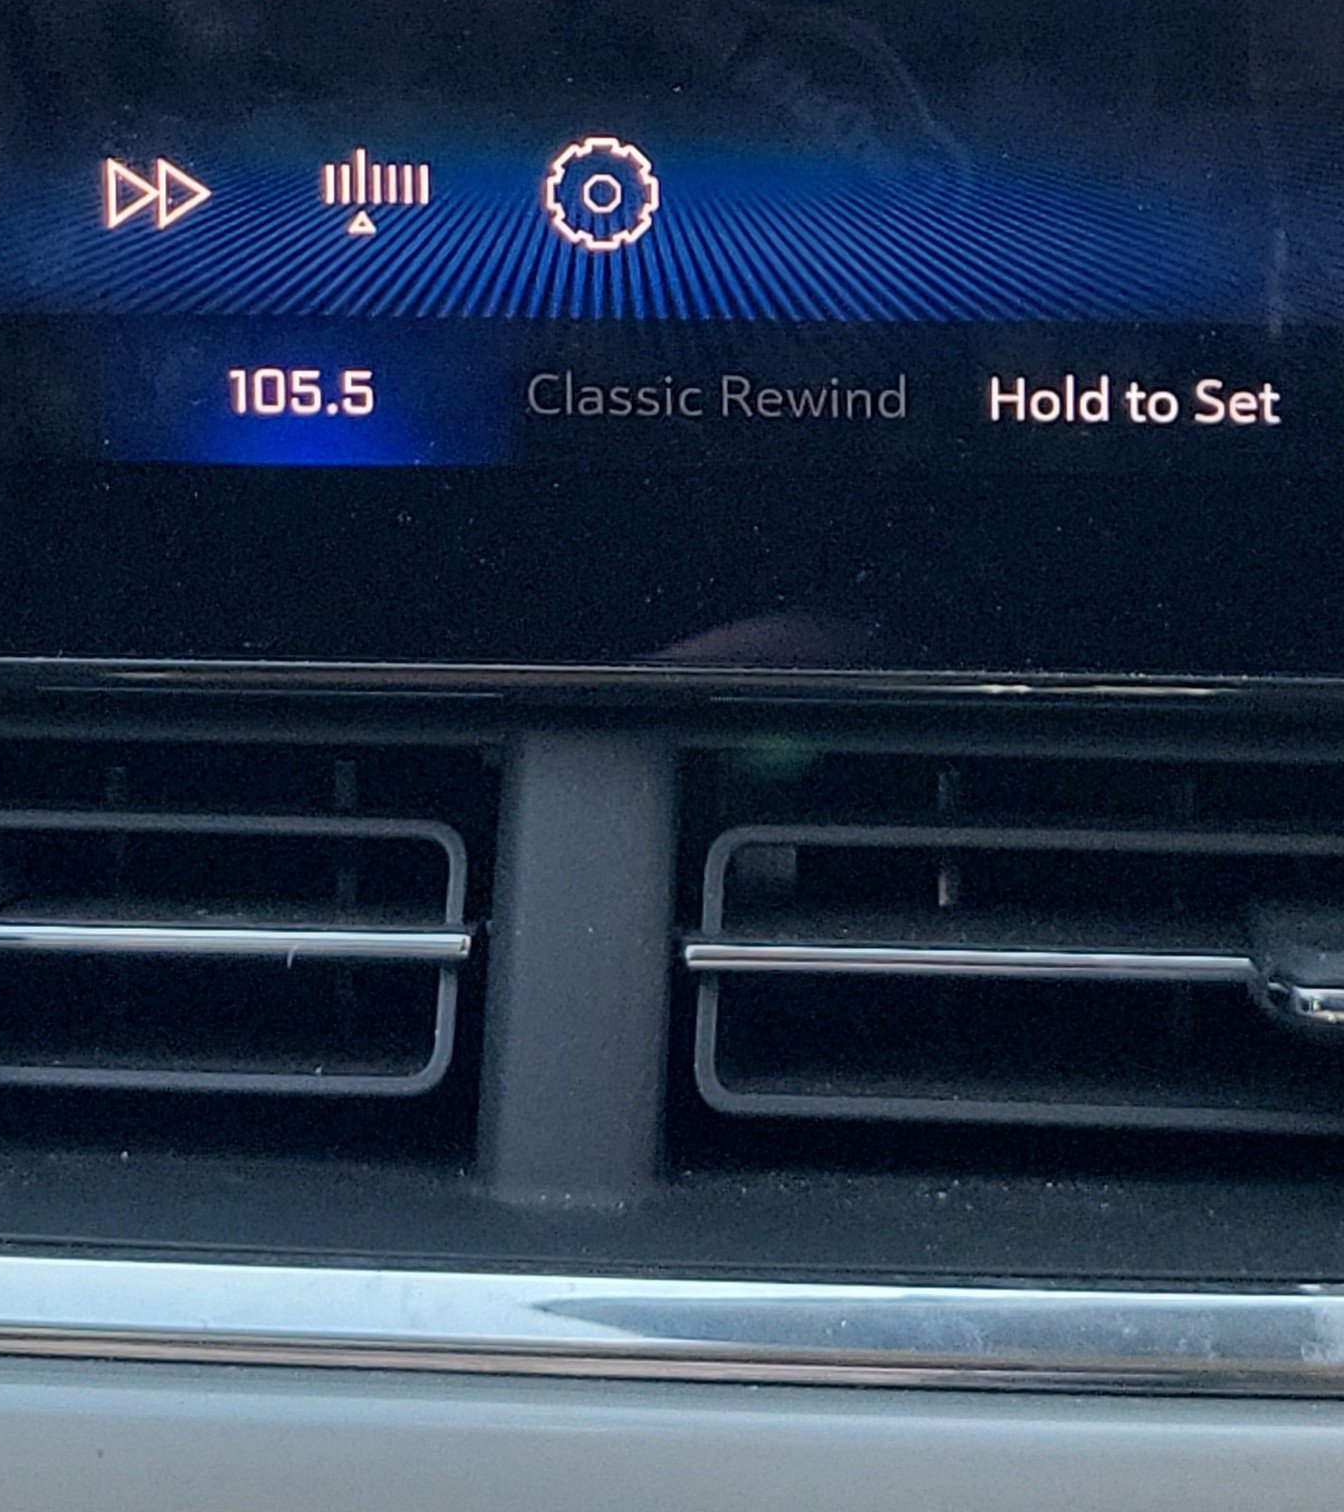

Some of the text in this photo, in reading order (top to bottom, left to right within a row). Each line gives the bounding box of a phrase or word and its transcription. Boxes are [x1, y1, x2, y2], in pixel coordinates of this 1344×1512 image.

[228, 367, 375, 416] 105.5
[527, 369, 908, 420] Classic Rewind
[990, 374, 1282, 425] Hold to Set
